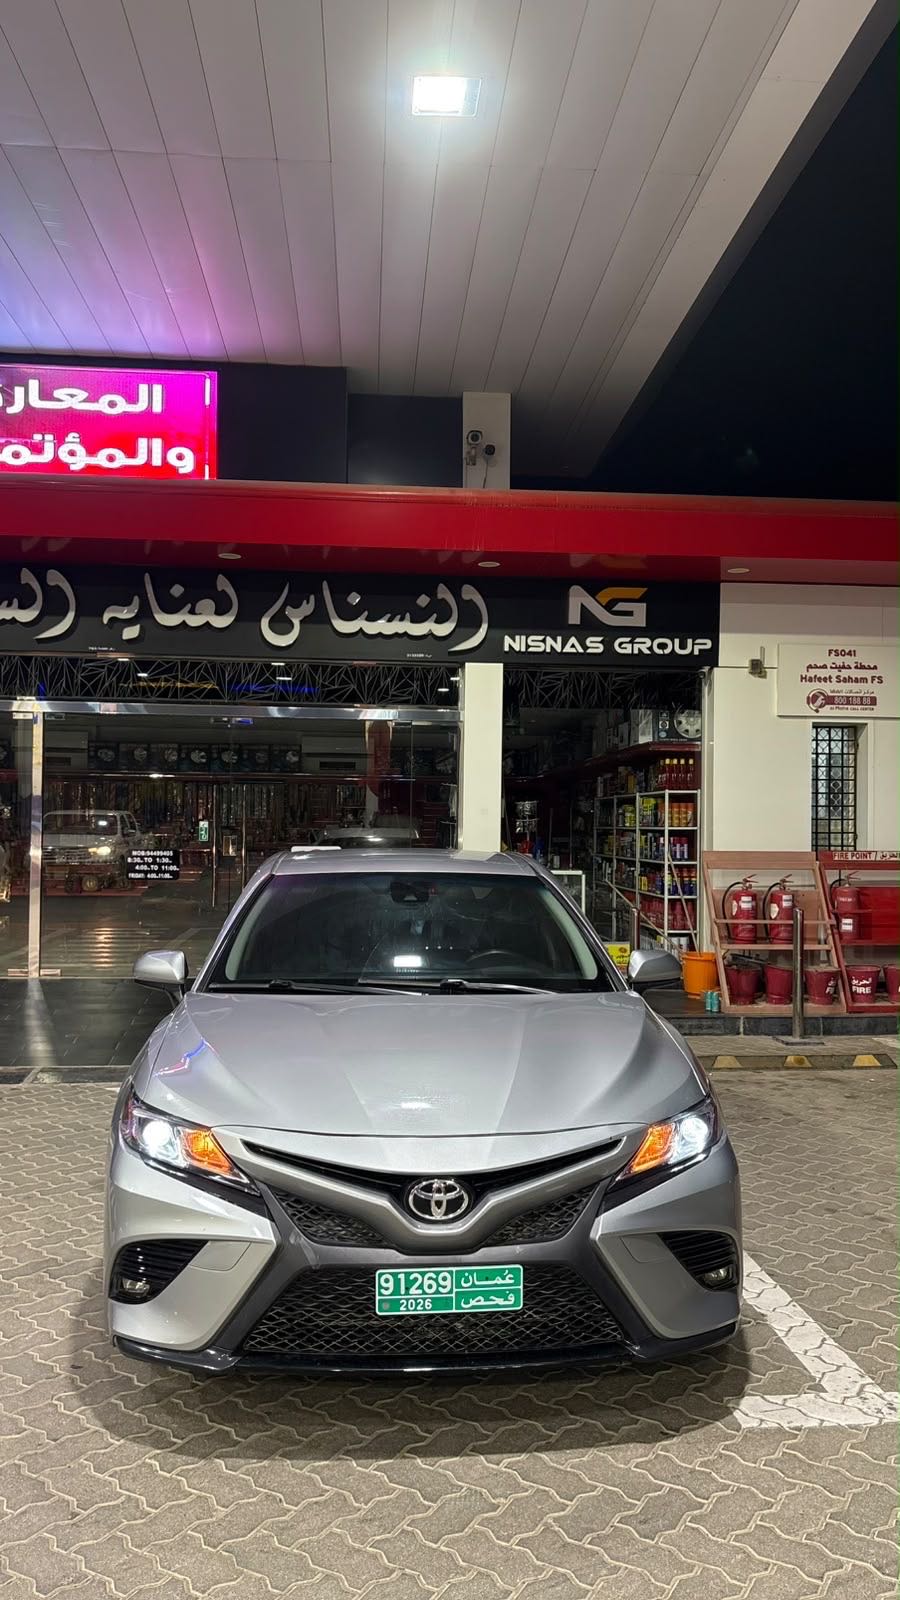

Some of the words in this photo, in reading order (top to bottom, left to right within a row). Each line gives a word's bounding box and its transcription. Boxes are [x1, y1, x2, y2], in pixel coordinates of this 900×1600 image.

[0, 379, 162, 414] المعار
[0, 432, 194, 474] والمؤتم
[0, 567, 76, 640] الس
[503, 635, 604, 654] NISNAS
[613, 637, 712, 656] GROUP
[828, 649, 857, 658] FS041
[806, 663, 828, 672] صحم
[829, 661, 852, 672] حفيت
[854, 661, 878, 671] محطة
[800, 674, 833, 684] Hafeet
[835, 675, 868, 684] Saham
[870, 676, 884, 685] FS
[834, 696, 847, 704] 800
[849, 697, 861, 705] 188
[862, 697, 872, 705] 88
[833, 852, 849, 860] FIRE
[850, 852, 872, 860] POINT
[852, 985, 872, 994] FIRE
[380, 1271, 452, 1295] 91269
[400, 1298, 432, 1311] 2026
[461, 1290, 515, 1308] فحص
